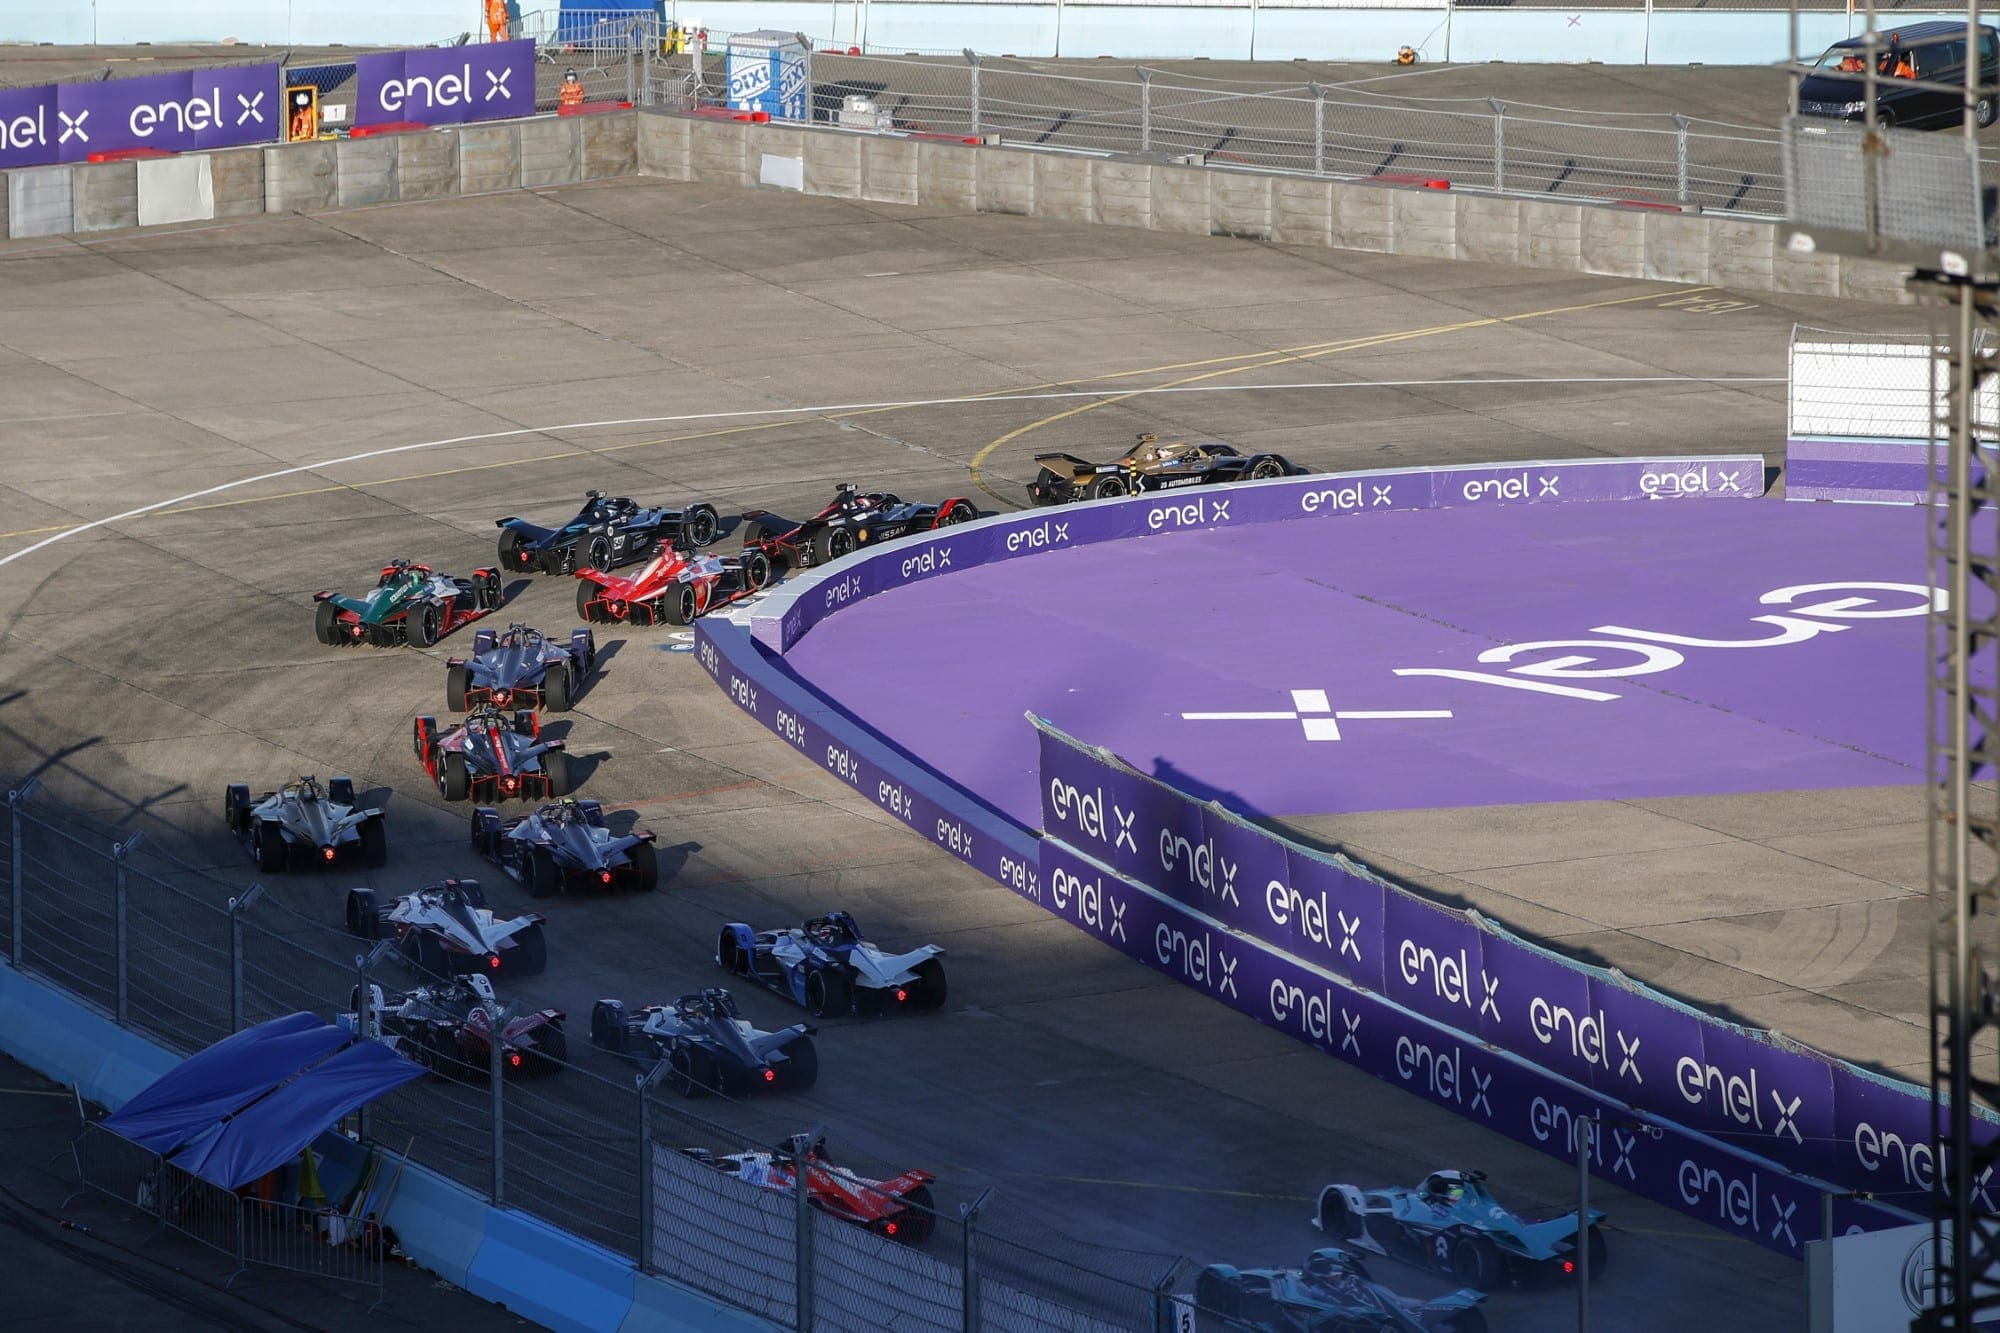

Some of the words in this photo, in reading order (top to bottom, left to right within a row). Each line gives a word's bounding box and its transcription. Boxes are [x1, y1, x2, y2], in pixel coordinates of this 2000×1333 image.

[380, 64, 471, 111] enel
[130, 88, 223, 136] enel
[1302, 482, 1363, 511] enel
[1464, 473, 1528, 500] enel
[1640, 467, 1709, 497] enel
[1149, 498, 1204, 528] enel
[1007, 522, 1049, 551] enel
[902, 547, 935, 577] enel
[826, 576, 849, 607] enel
[701, 640, 713, 672] enel
[731, 675, 748, 706] enel
[777, 710, 795, 740] enel
[828, 744, 847, 774] enel
[879, 780, 901, 812] enel
[1051, 777, 1106, 842] enel
[937, 818, 961, 850] enel
[1000, 856, 1026, 891] enel
[1160, 829, 1215, 894] enel
[1052, 868, 1103, 930] enel
[1267, 881, 1331, 948] enel
[1156, 923, 1211, 986] enel
[1400, 940, 1471, 1008] enel
[1271, 979, 1332, 1042] enel
[1530, 997, 1608, 1069] enel
[1396, 1036, 1461, 1103] enel
[1677, 1057, 1762, 1129] enel
[1855, 1123, 1949, 1200] enel
[1679, 1160, 1759, 1232] enel
